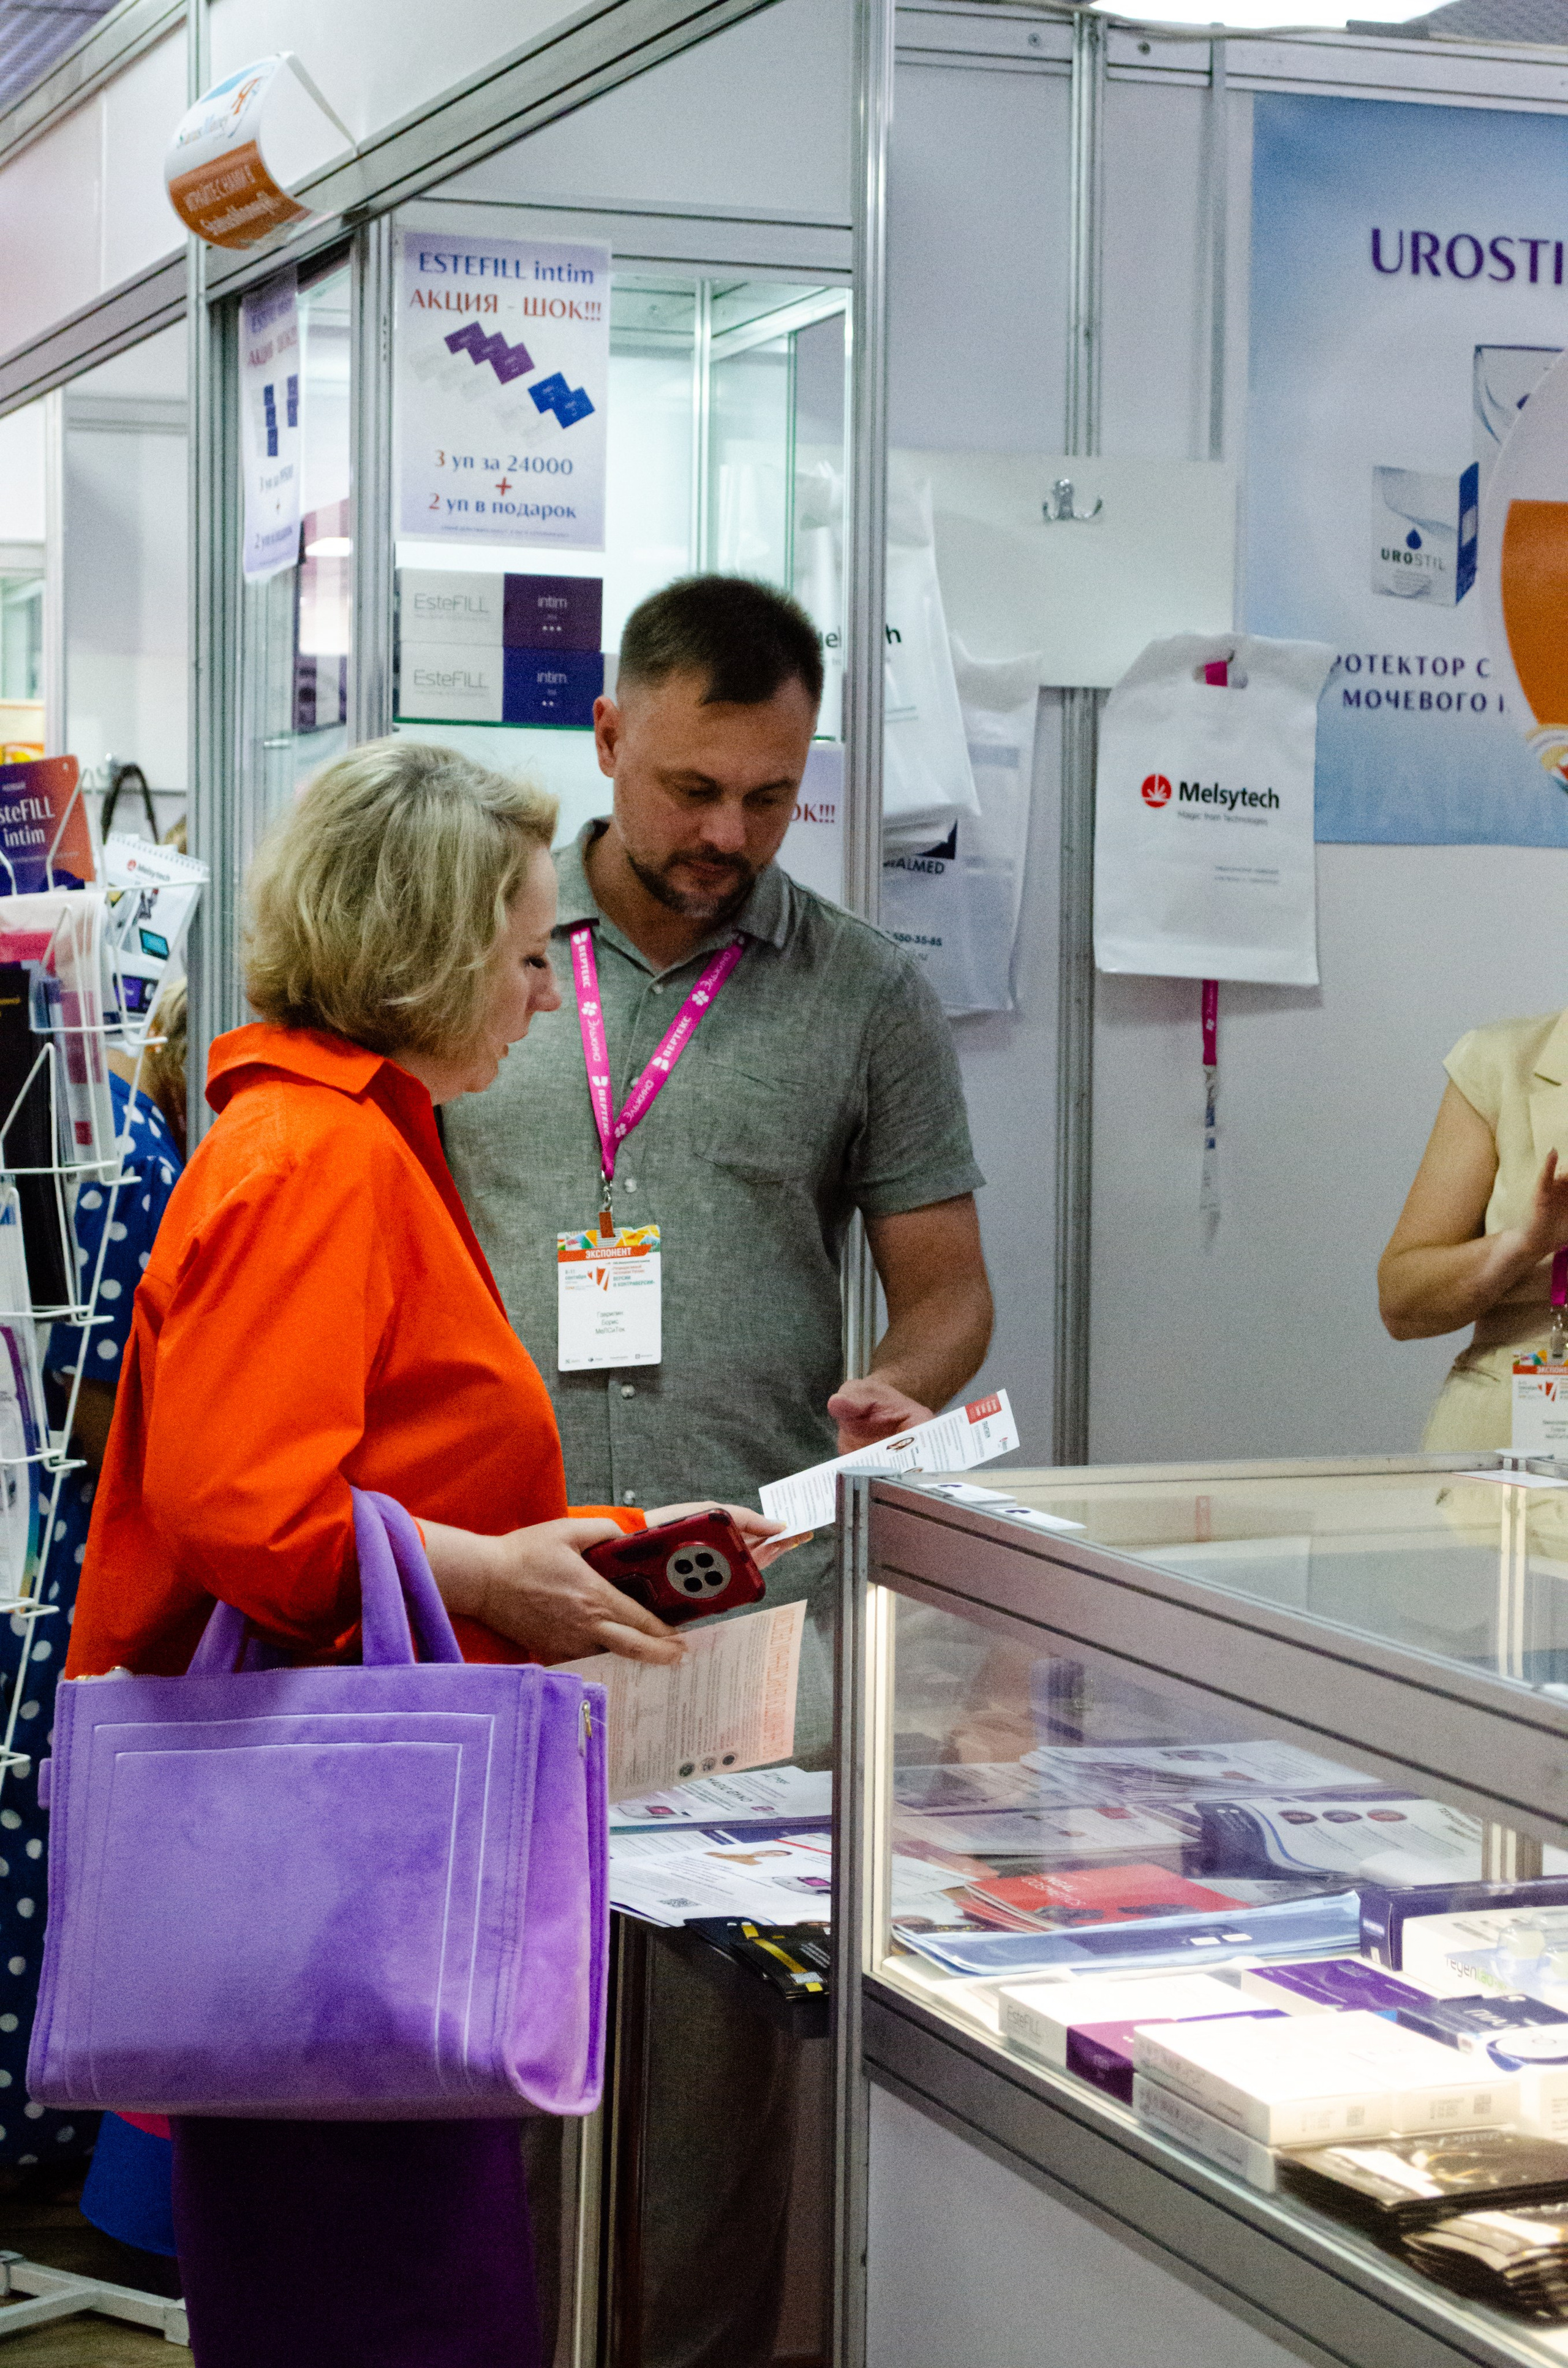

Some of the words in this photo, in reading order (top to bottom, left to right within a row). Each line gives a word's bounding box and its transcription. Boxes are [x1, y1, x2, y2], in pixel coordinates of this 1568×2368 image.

[419, 251, 527, 279] ESTEFILL
[535, 260, 594, 284] intim
[1371, 227, 1564, 286] UROSTI
[409, 288, 498, 315] АКЦИЯ
[524, 296, 601, 322] ШОК!!!
[434, 449, 445, 467] 3
[452, 454, 475, 472] уп
[481, 456, 500, 471] за
[507, 454, 574, 476] 24000
[428, 492, 440, 510] 2
[446, 497, 469, 515] уп
[475, 501, 486, 513] в
[492, 501, 577, 521] подарок
[1381, 547, 1446, 571] UROSTIL
[413, 592, 489, 613] EsteFILL
[537, 595, 568, 610] intim
[413, 668, 490, 690] EsteFILL
[537, 670, 568, 685] intim
[1337, 653, 1466, 678] ОТЕКТОР
[1343, 688, 1487, 714] МОЧЕВОГО
[1178, 780, 1280, 811] Melsytech
[2, 825, 45, 848] intim
[577, 944, 592, 988] ВЕРТЕКС
[662, 1016, 693, 1057] ВЕРТЕКС
[598, 1089, 611, 1137] ВЕРТЕКС
[585, 1247, 631, 1259] ЭКСПОНЕНТ
